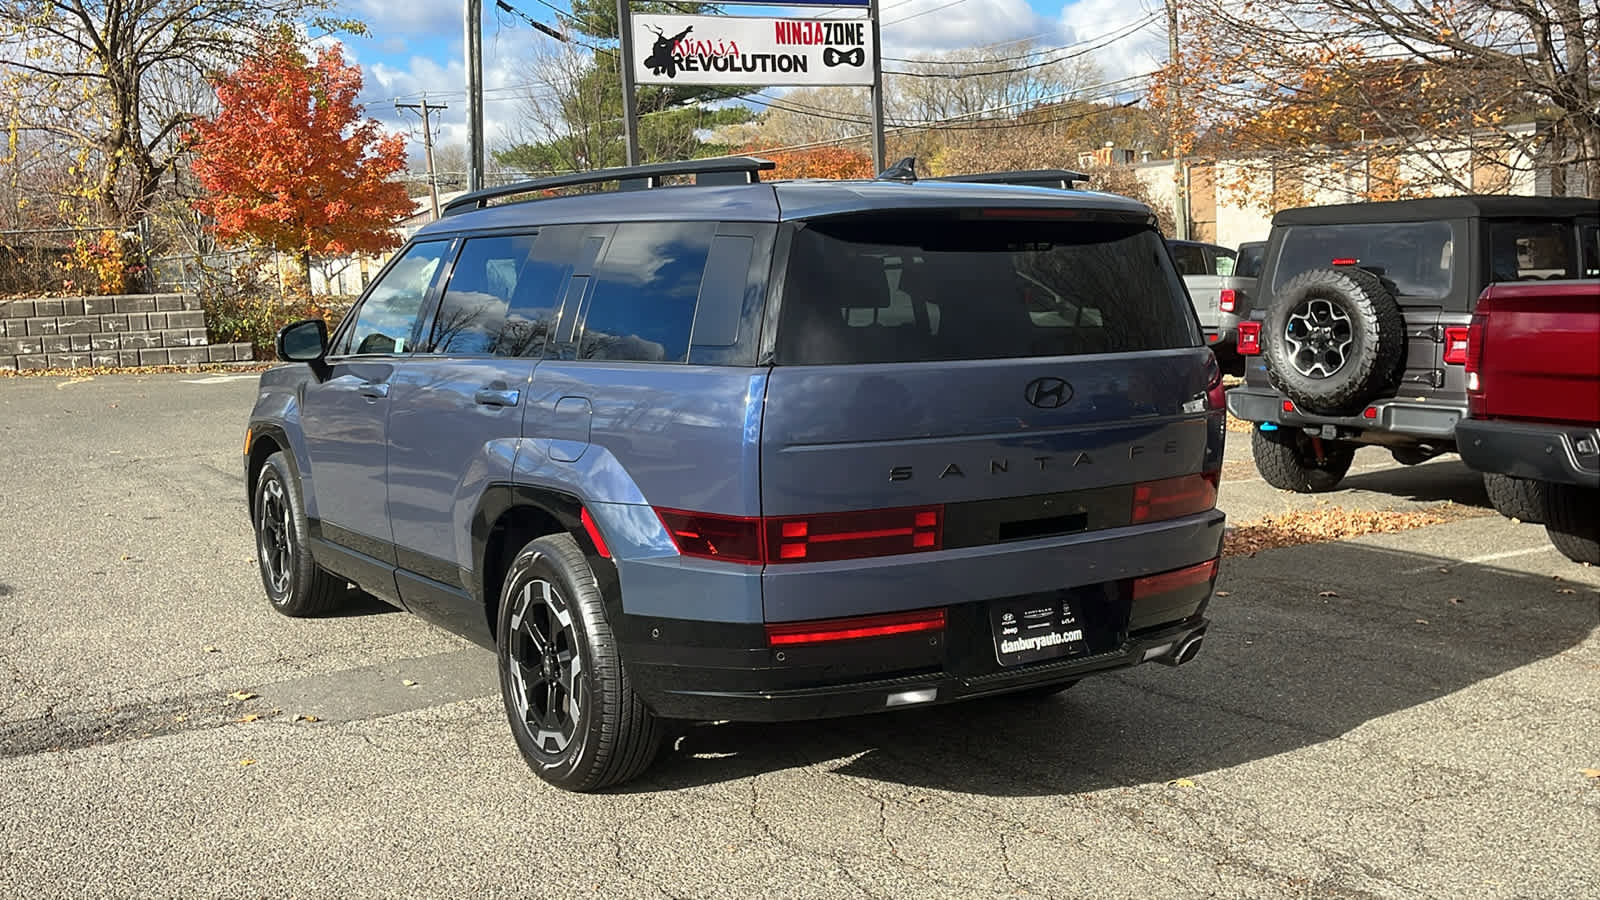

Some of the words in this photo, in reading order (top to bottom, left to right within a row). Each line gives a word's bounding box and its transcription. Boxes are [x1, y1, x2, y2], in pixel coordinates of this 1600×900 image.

[775, 21, 865, 46] NINJAZONE
[672, 53, 808, 73] REVOLUTION
[889, 451, 1094, 482] SANTA
[1127, 440, 1178, 460] FE
[1001, 629, 1083, 654] danburyauto.com
